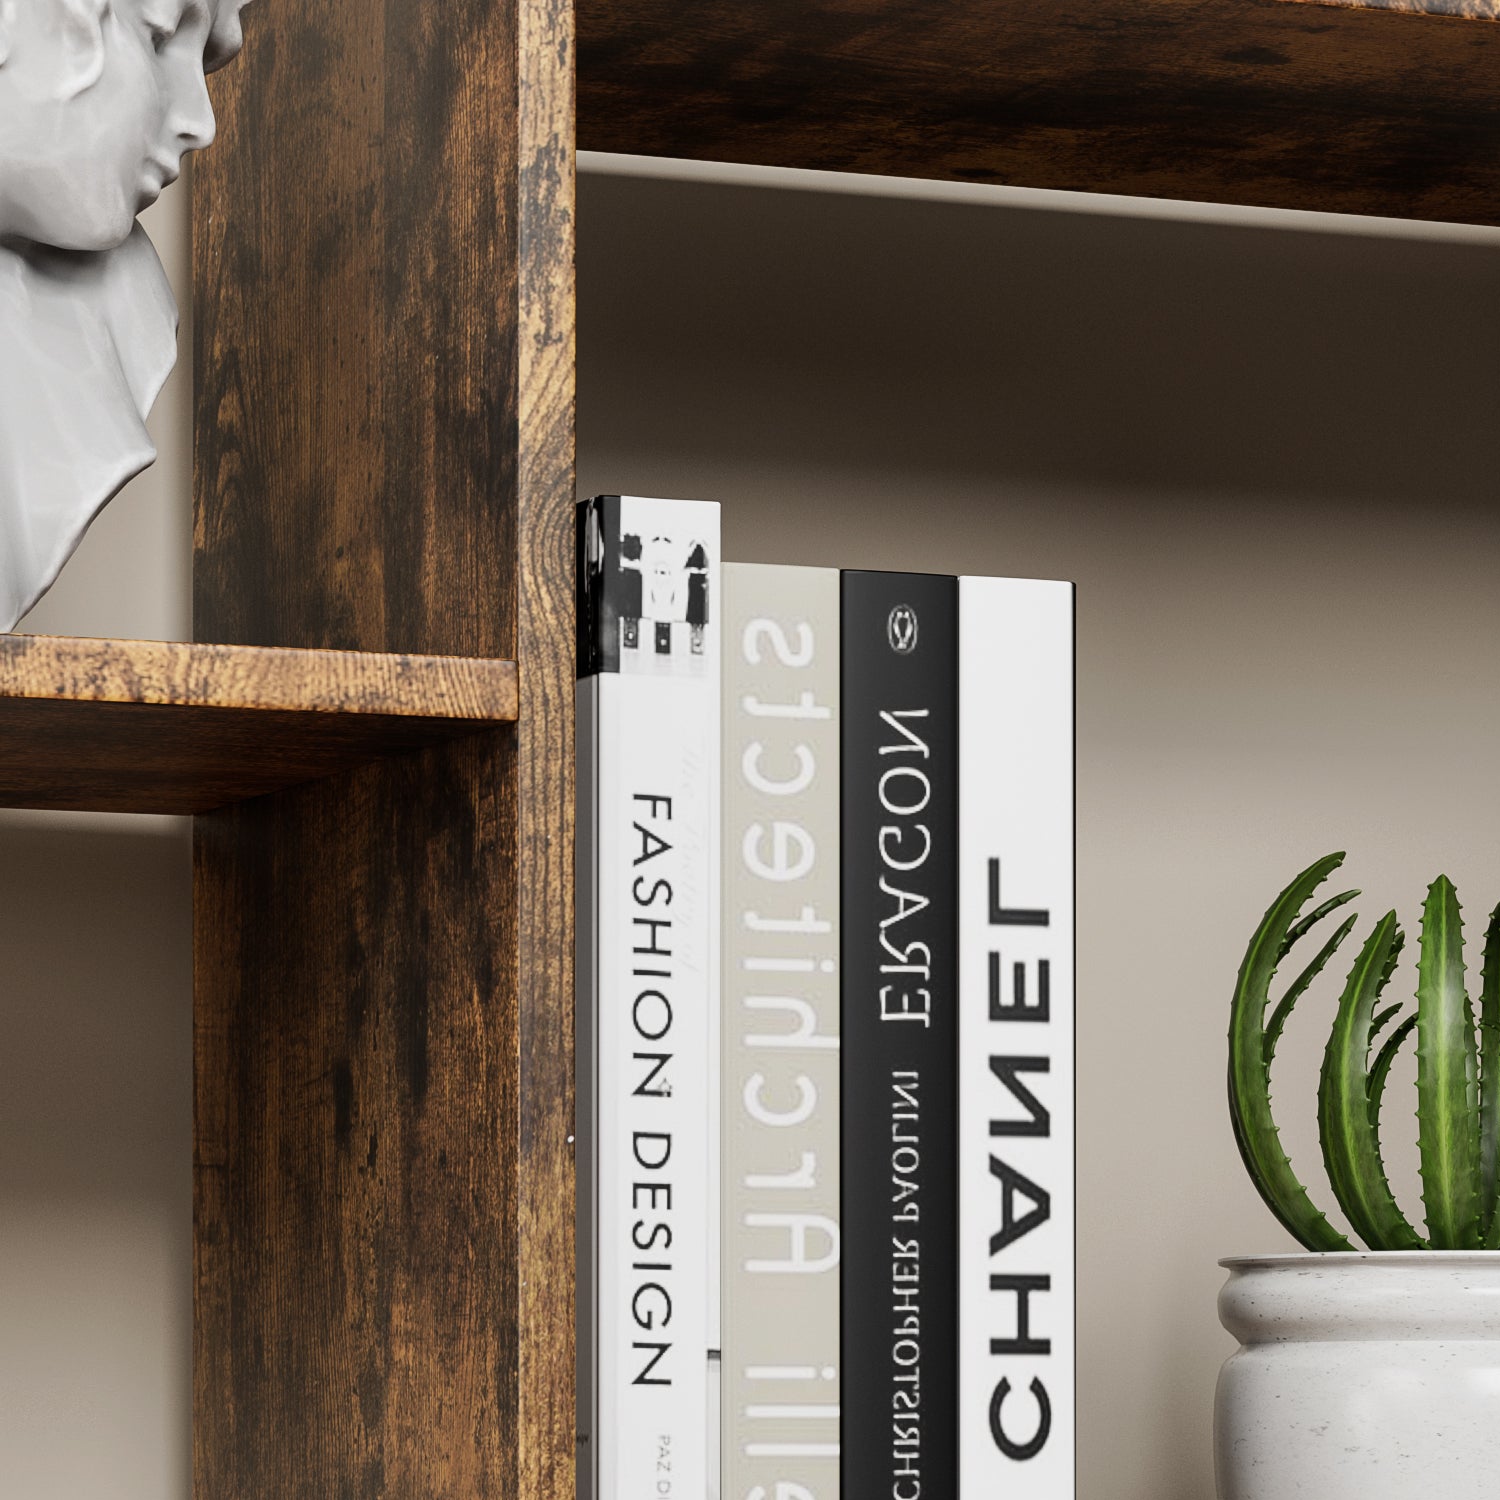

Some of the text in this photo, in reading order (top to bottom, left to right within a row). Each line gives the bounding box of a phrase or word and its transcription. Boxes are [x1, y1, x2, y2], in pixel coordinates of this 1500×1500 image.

[631, 793, 673, 1386] FASHION DESIGN
[656, 1435, 671, 1473] PAZ
